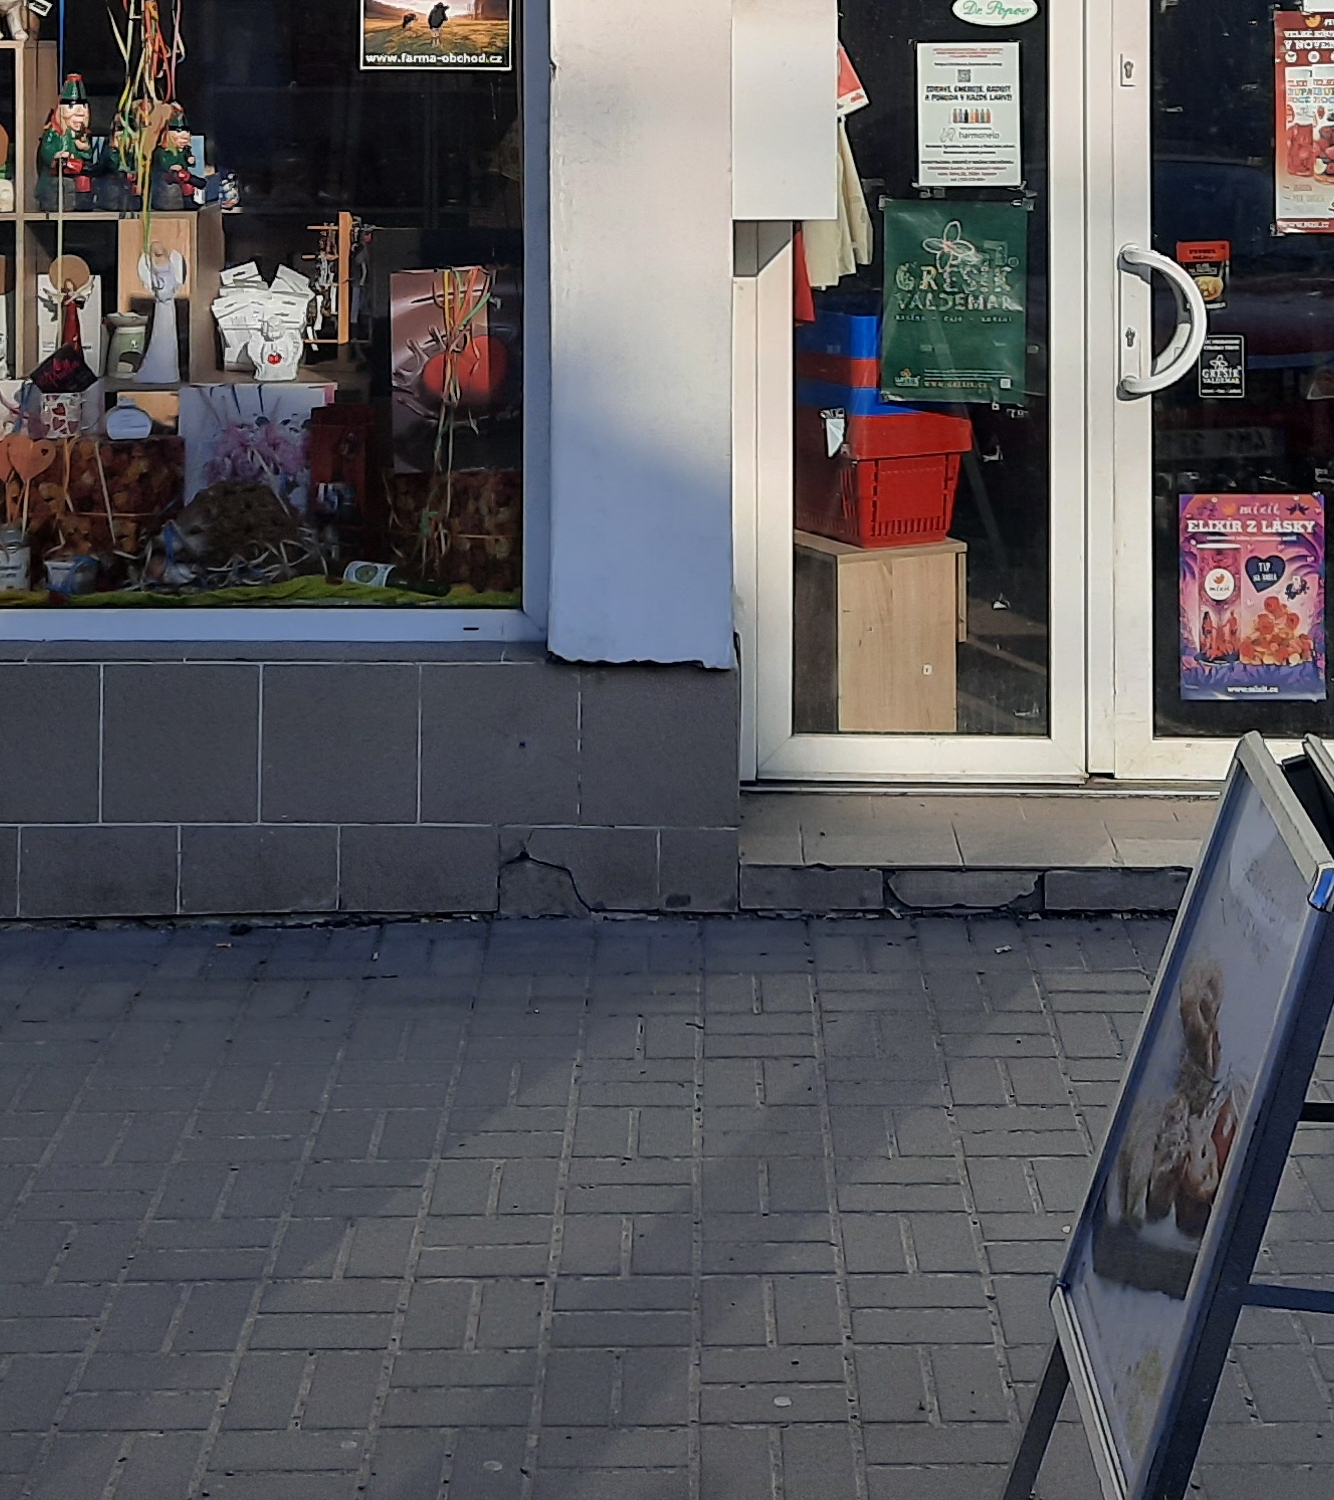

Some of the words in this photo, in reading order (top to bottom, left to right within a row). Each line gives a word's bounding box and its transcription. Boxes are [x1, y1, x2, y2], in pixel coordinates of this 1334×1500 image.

[963, 0, 982, 15] Dr.
[365, 53, 502, 63] www.farma-obchod.cz
[898, 293, 1017, 311] VALDEMAR
[1239, 503, 1280, 514] mixit
[1187, 517, 1243, 532] ELIXÍR
[1247, 520, 1257, 532] Z
[1261, 518, 1316, 533] LÁSKY
